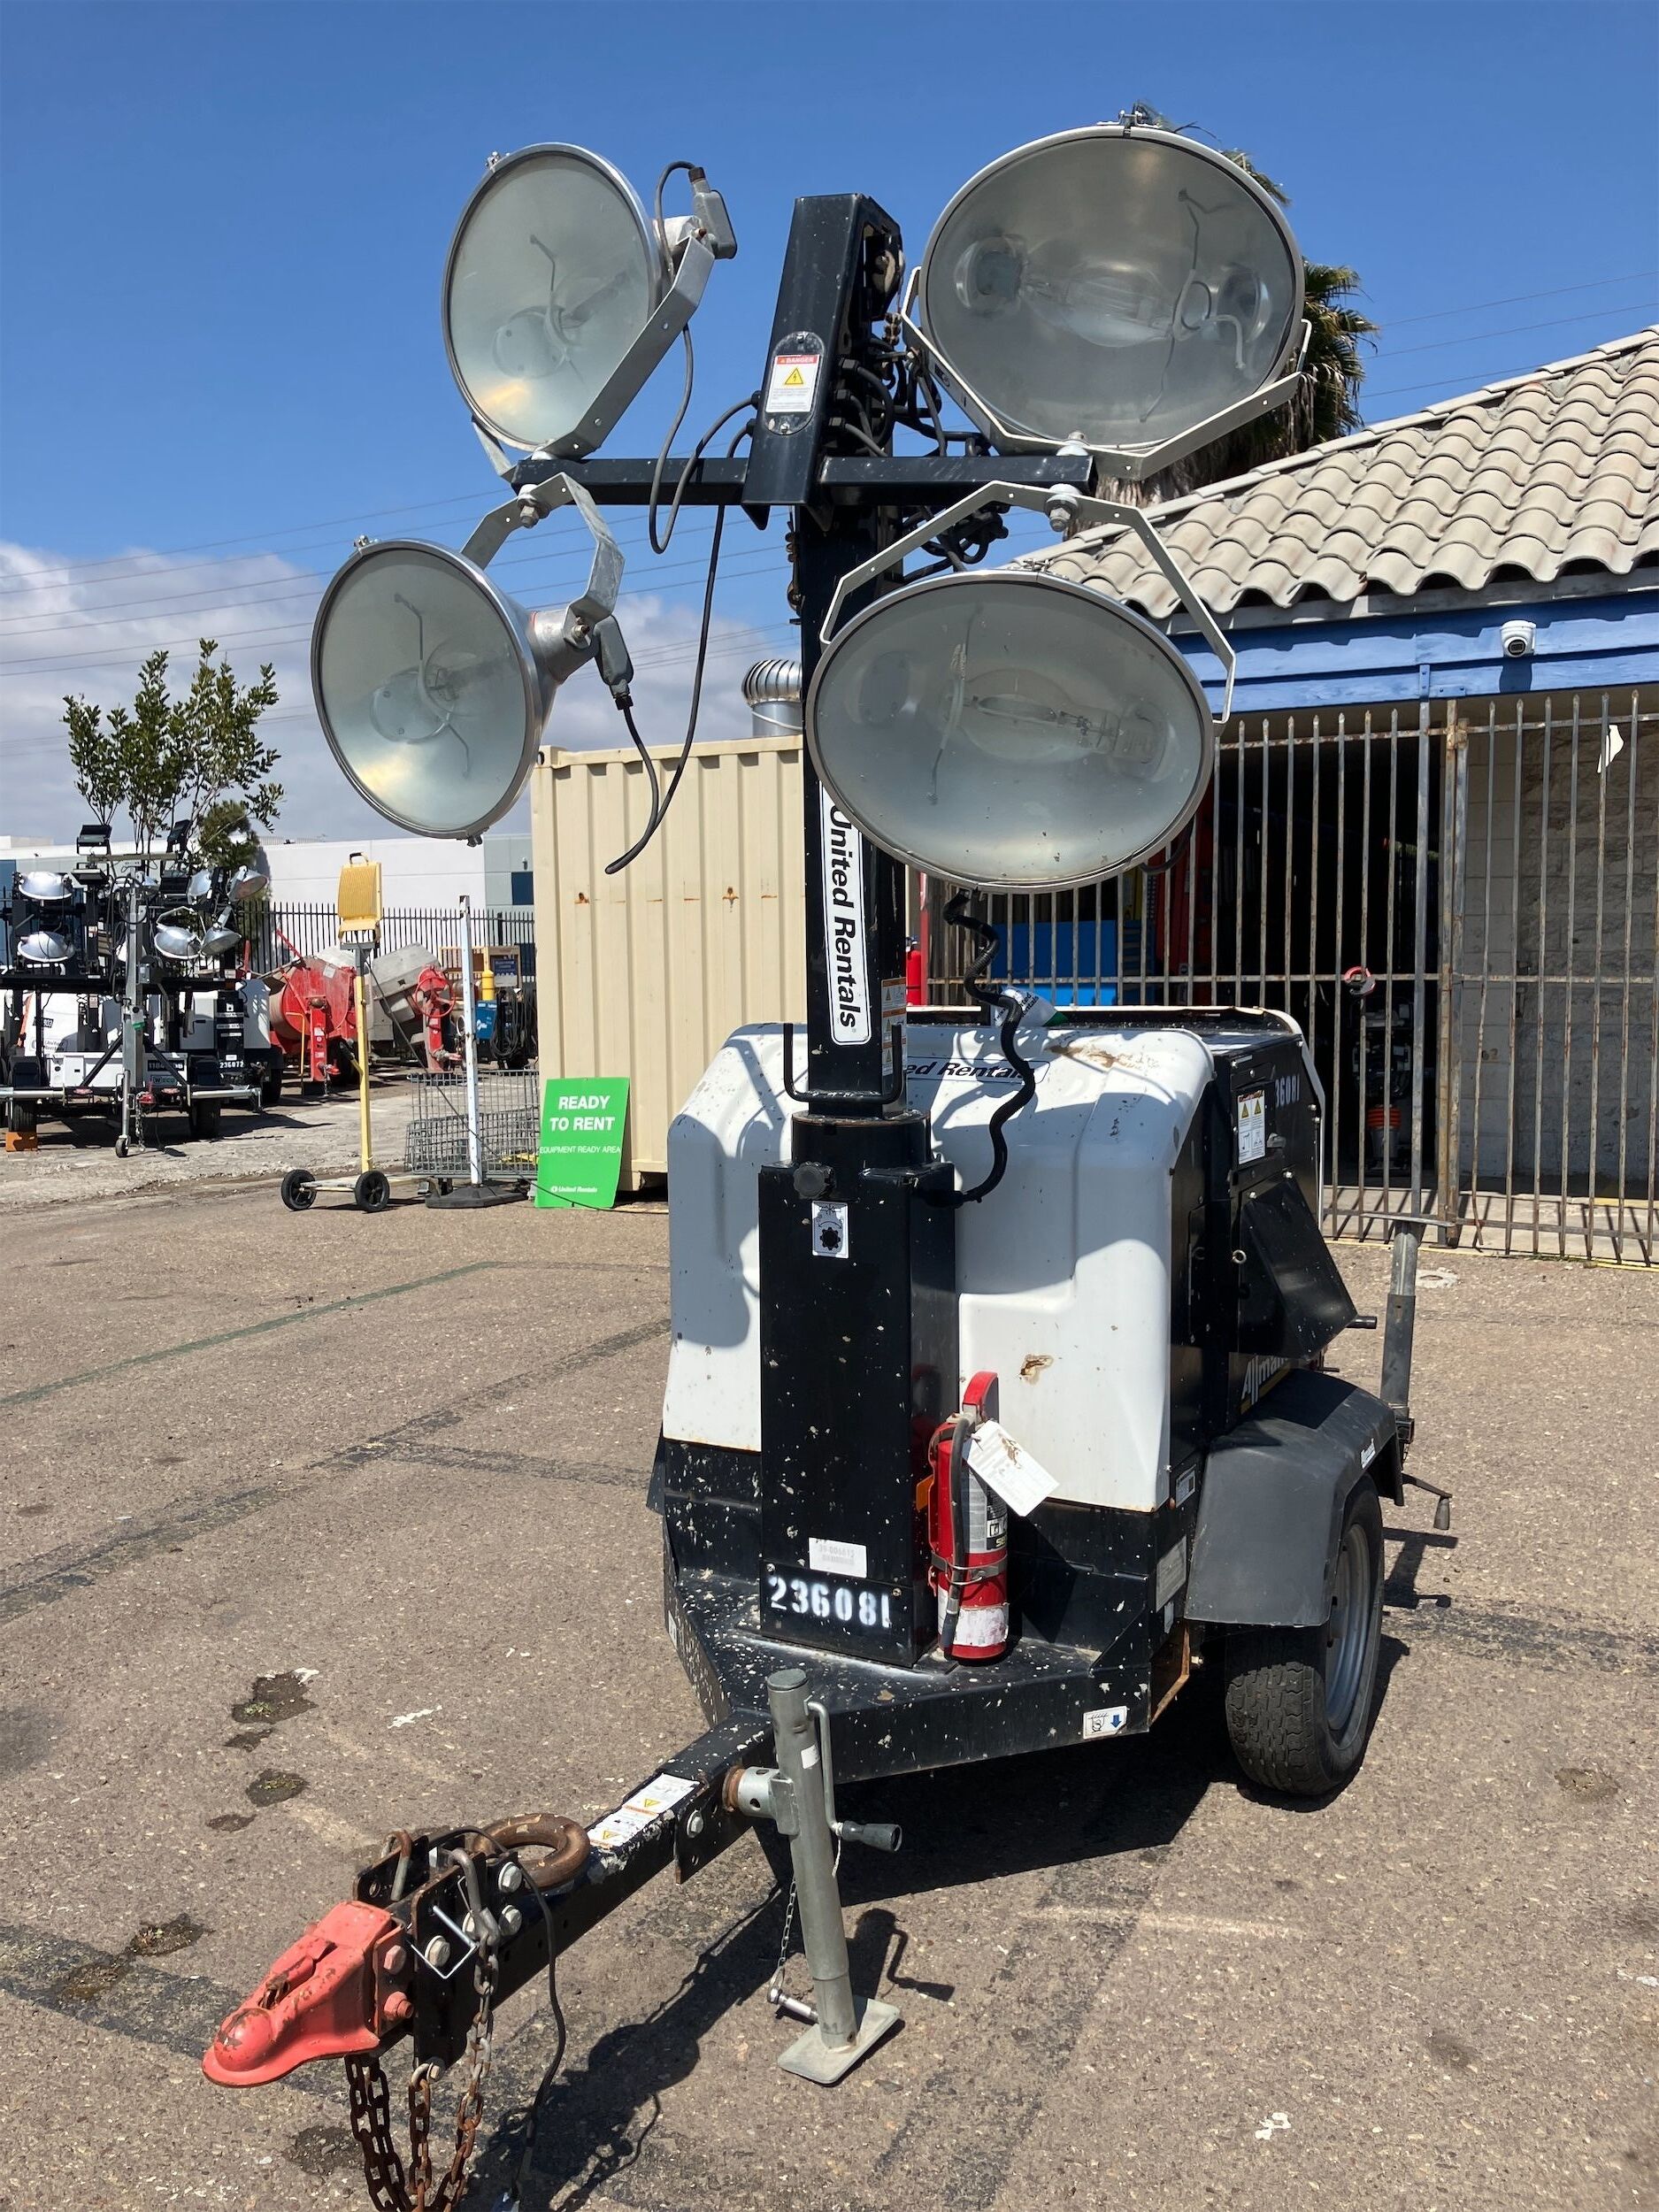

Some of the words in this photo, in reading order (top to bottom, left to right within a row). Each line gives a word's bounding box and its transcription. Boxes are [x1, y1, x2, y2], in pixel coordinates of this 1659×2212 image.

[830, 805, 854, 909] United
[834, 916, 861, 1028] Rentals
[938, 1062, 1023, 1079] Rental
[558, 1095, 611, 1110] READY
[550, 1117, 569, 1131] TO
[573, 1117, 616, 1131] RENT
[768, 1577, 890, 1628] 236081
